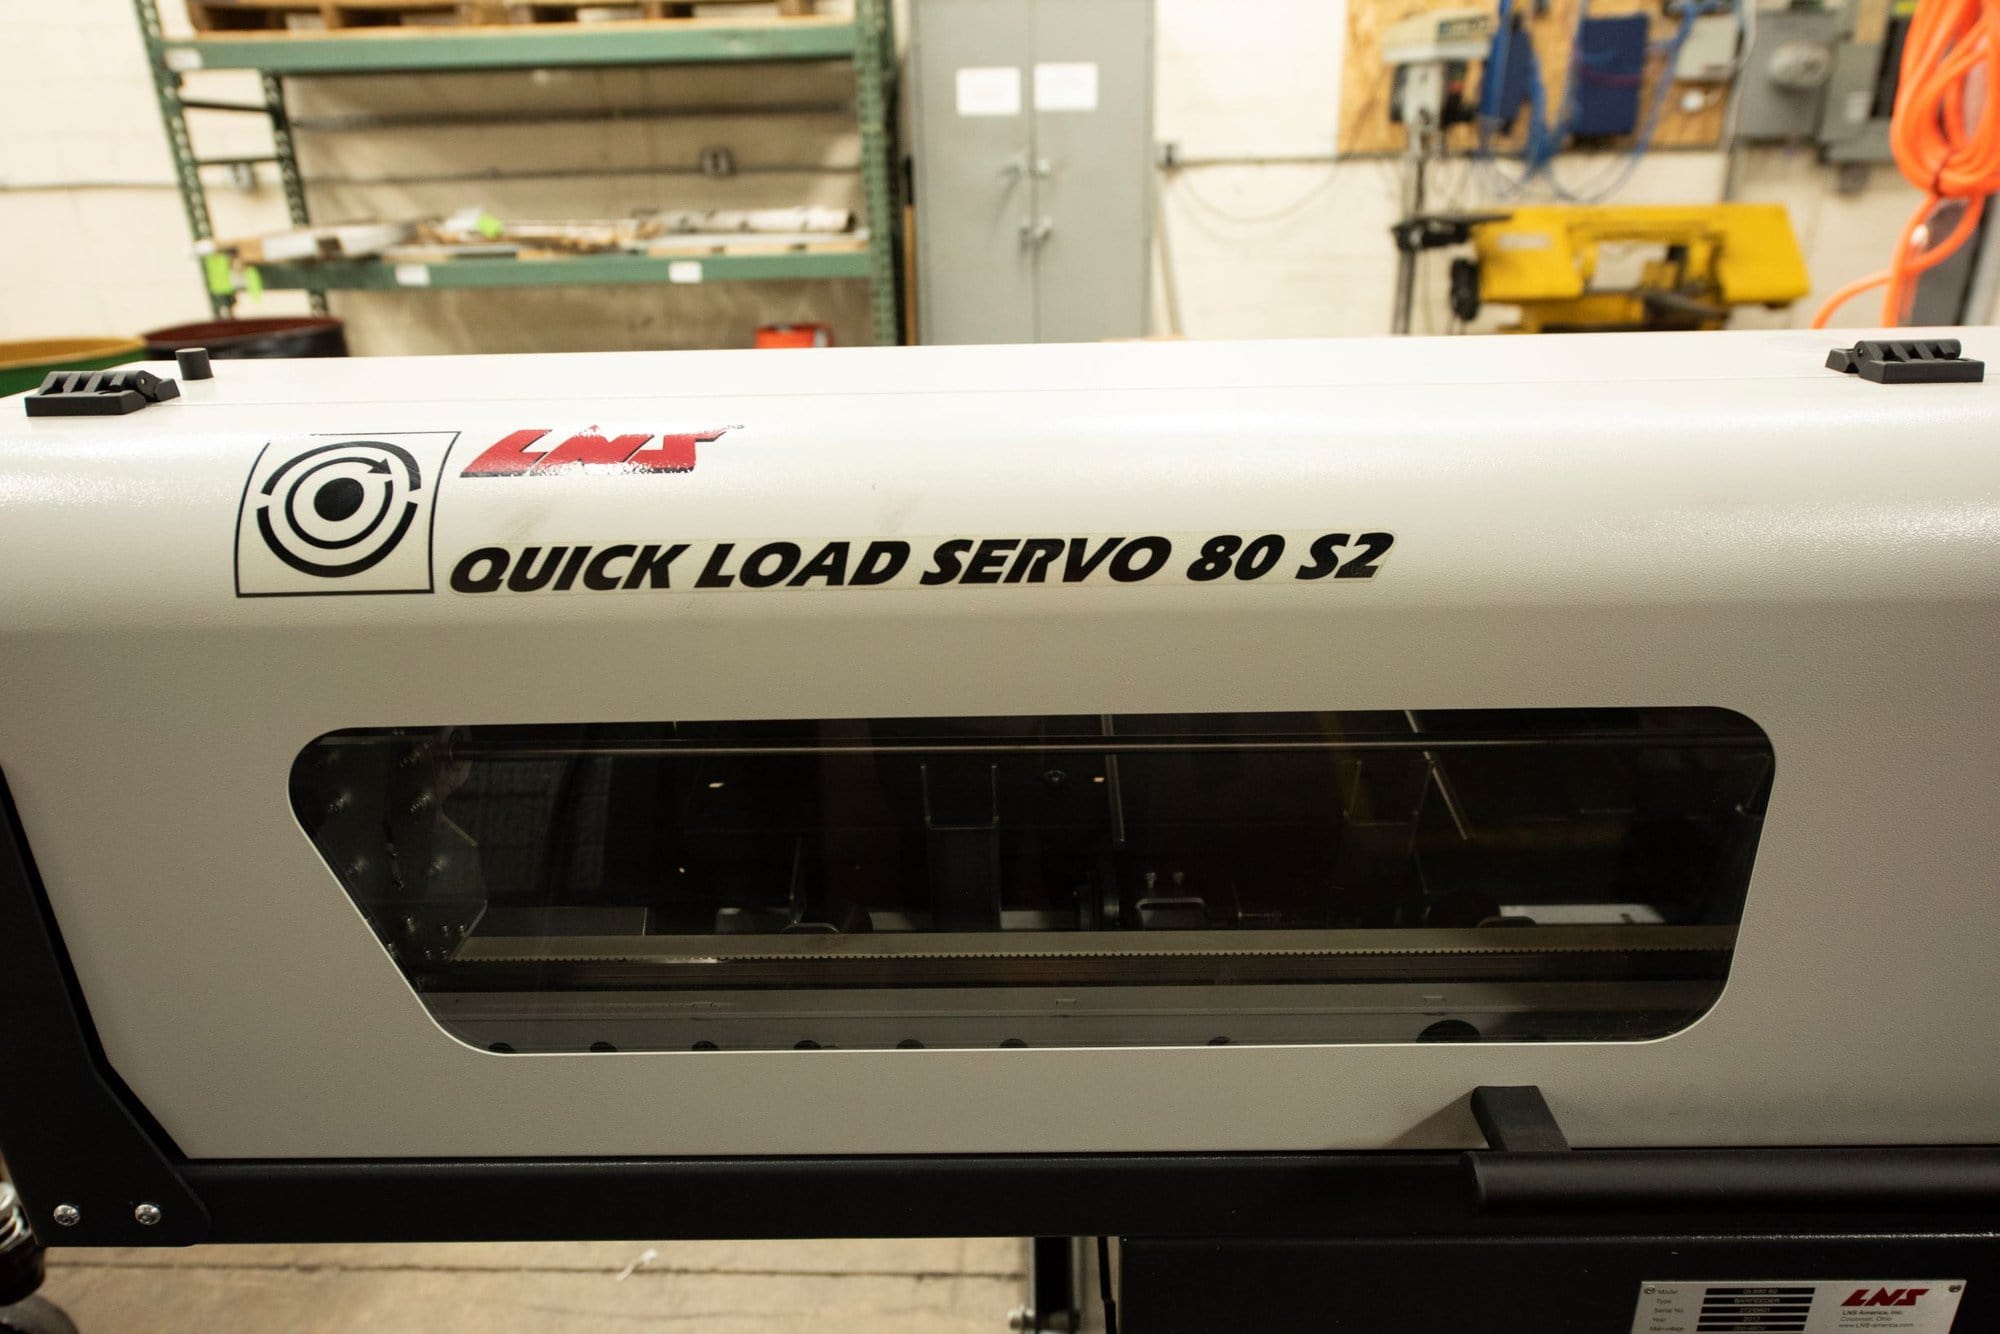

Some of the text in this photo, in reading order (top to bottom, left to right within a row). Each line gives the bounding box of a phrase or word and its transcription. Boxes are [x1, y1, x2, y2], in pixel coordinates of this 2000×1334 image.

[460, 425, 734, 478] LNS
[449, 532, 1396, 593] QUICK LOAD SERVO 80 S2
[1840, 1287, 1930, 1306] LNS
